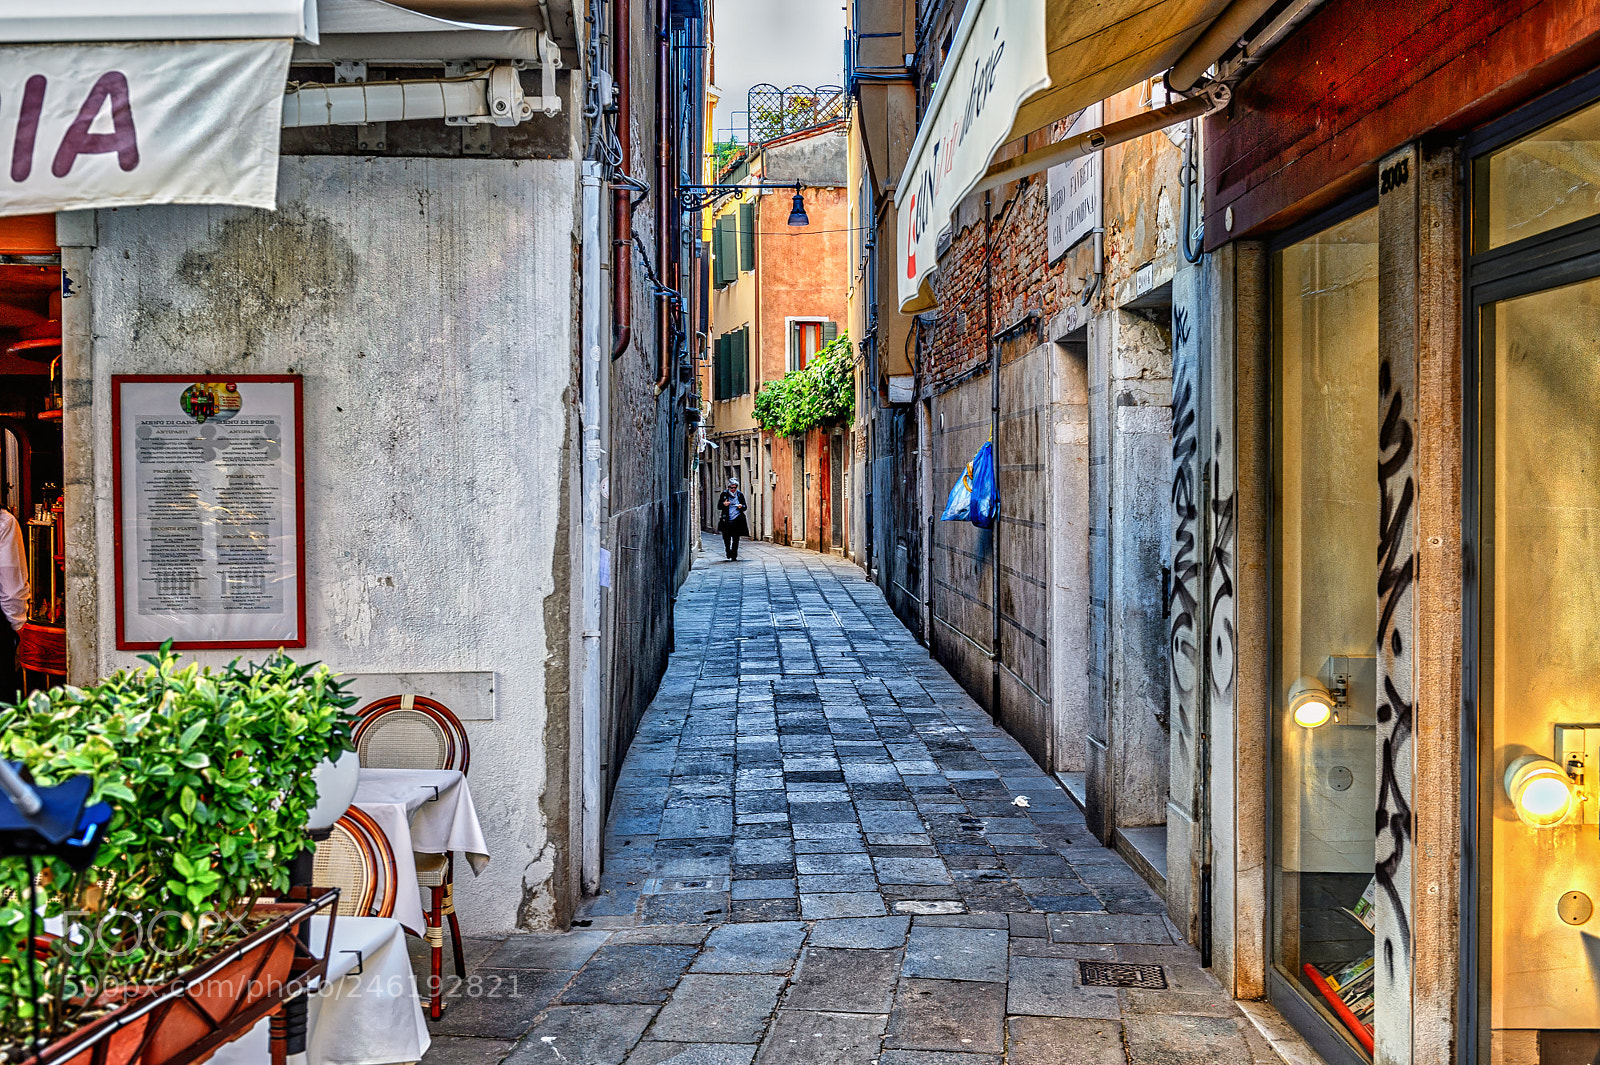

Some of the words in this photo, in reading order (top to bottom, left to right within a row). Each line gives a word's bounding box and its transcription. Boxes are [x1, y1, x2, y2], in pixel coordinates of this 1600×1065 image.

[0, 70, 140, 183] IA
[1050, 185, 1066, 216] PIERO
[1069, 156, 1095, 198] FAVRETT
[1380, 157, 1410, 195] 2003
